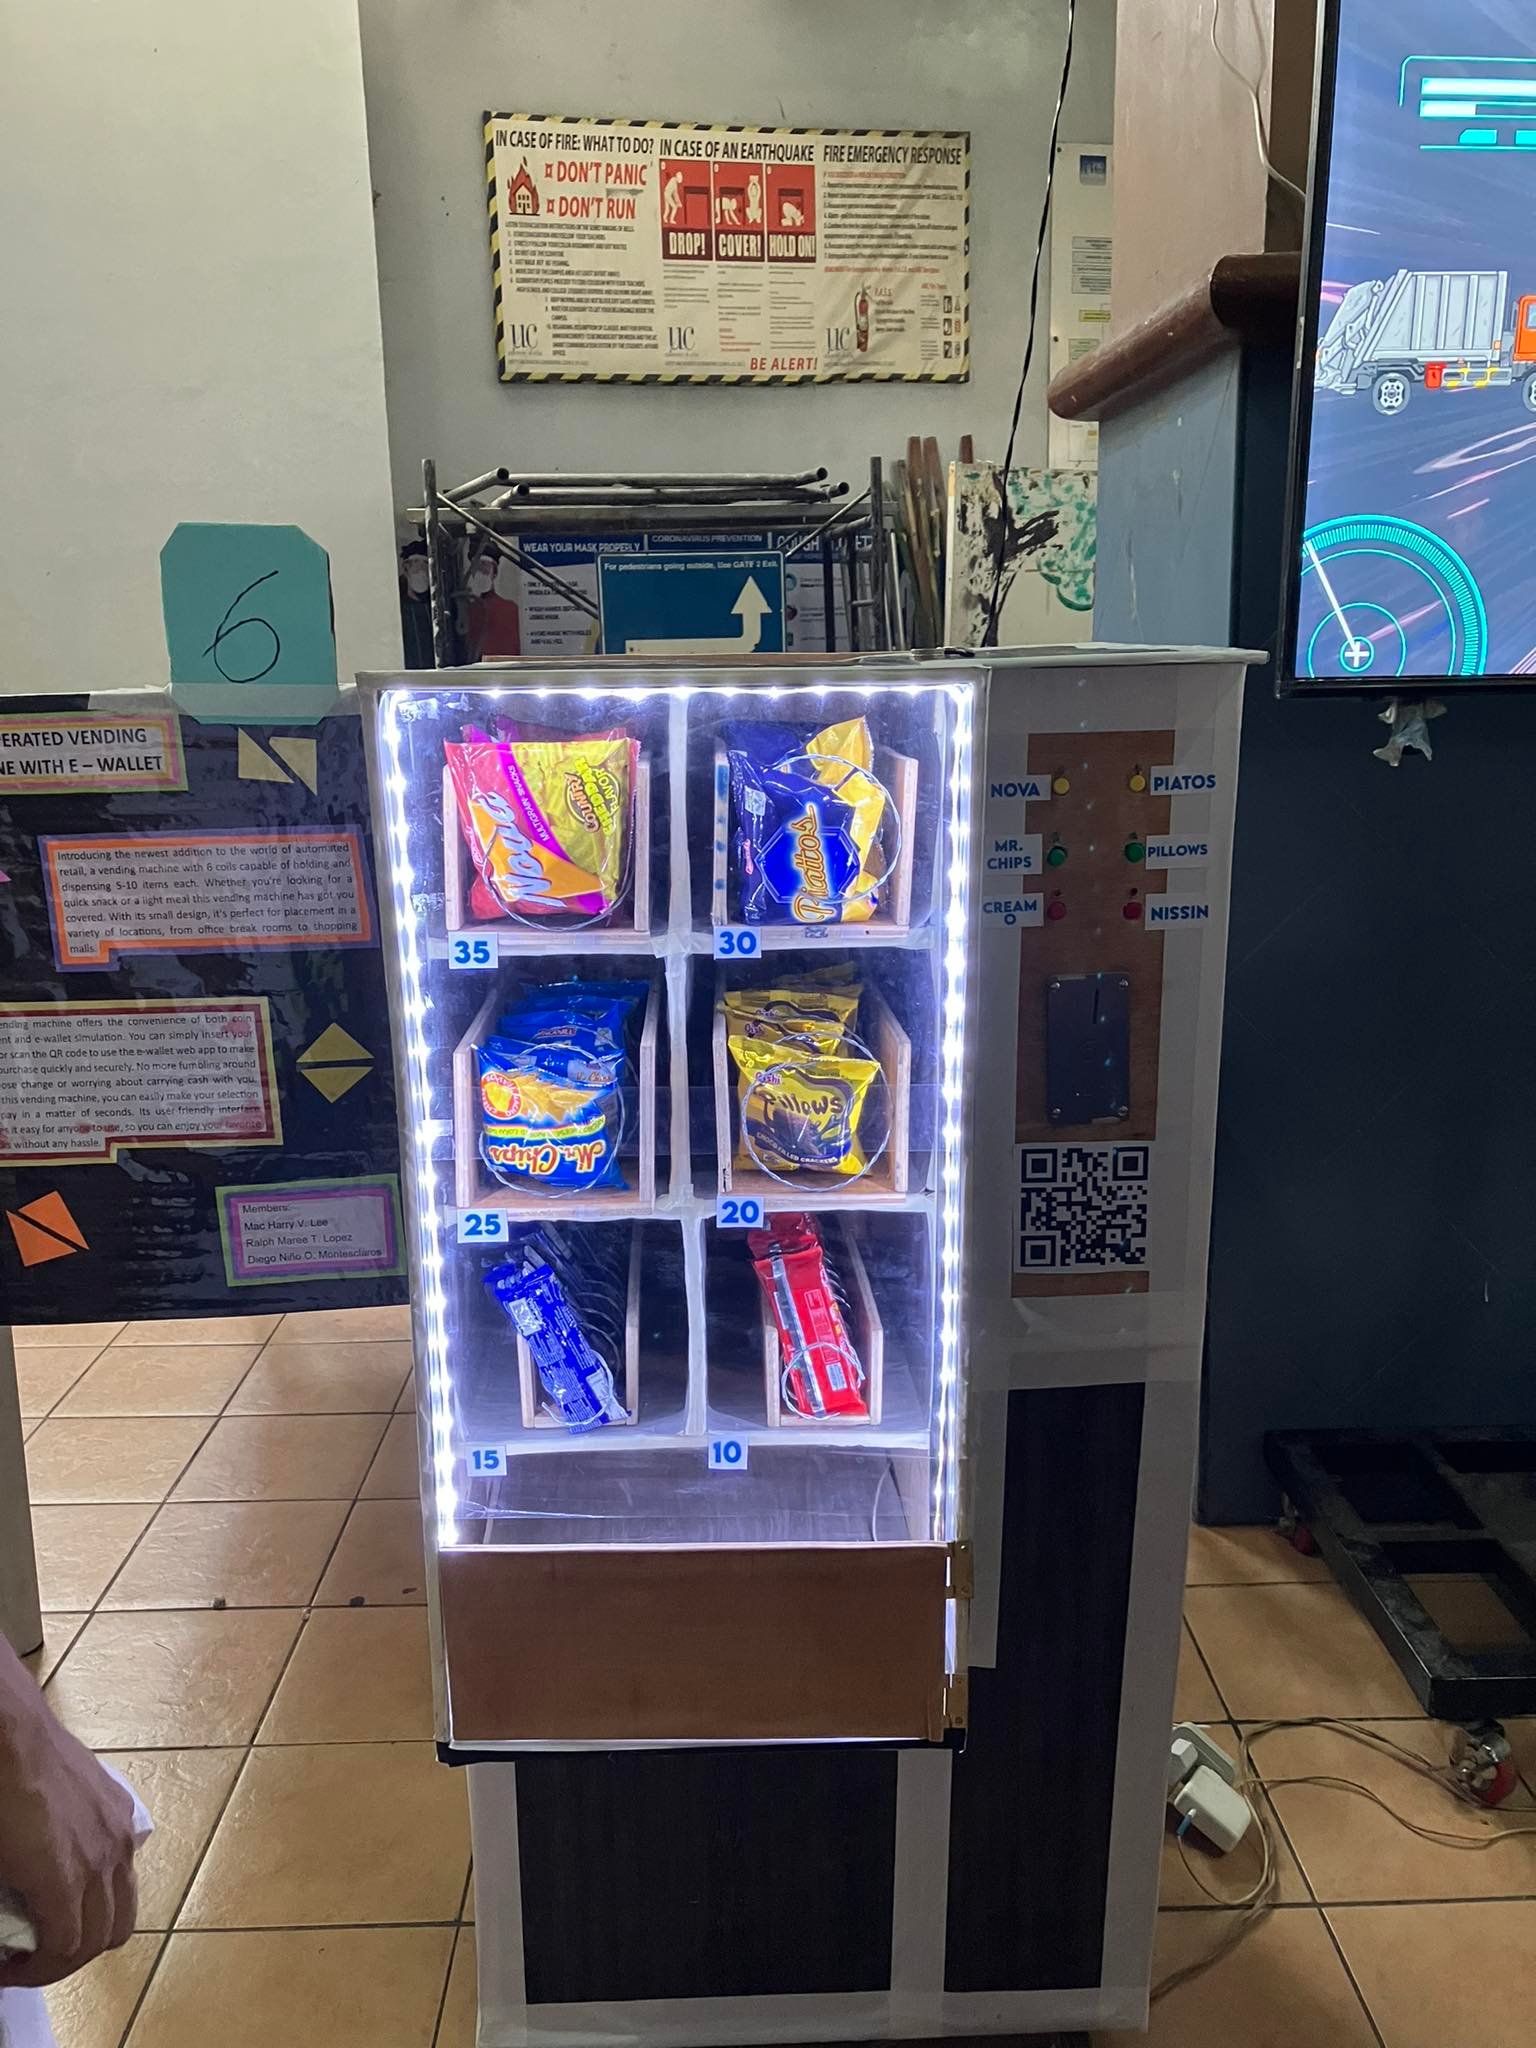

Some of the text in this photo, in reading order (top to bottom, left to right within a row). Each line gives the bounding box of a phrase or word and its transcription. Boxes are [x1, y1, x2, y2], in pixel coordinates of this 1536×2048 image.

[496, 130, 654, 154] IN CASE OF FIRE: WHAT TO DO?
[660, 139, 814, 162] IN CASE OF AN EARTHQUAKE
[824, 145, 961, 164] FIRE EMERGENCY RESPONSE
[557, 161, 647, 185] DON'T PANIC
[559, 196, 636, 219] DON'T RUN
[669, 232, 705, 255] DROP!
[719, 234, 761, 257] COVER!
[769, 235, 815, 257] HOLD ON!
[750, 357, 818, 370] BE ALERT!
[523, 543, 640, 552] WEAR YOUR MASK PROPERLY
[619, 563, 661, 571] pedestrians
[663, 563, 685, 571] going
[202, 571, 280, 683] 6
[0, 728, 147, 747] ERATED VENDING
[20, 759, 64, 774] WITH
[69, 759, 78, 772] E
[97, 756, 162, 772] WALLET
[991, 783, 1040, 797] NOVA
[1154, 775, 1216, 790] PIATOS
[575, 758, 613, 836] CHEDDAR
[593, 768, 620, 816] FLAVOR
[508, 765, 550, 842] MULTIGRAIN SNACKS
[565, 772, 600, 833] COUNTRY
[472, 788, 568, 908] Nova
[995, 840, 1022, 851] MR.
[1148, 844, 1208, 857] PILLOWS
[58, 852, 111, 860] Introducing
[135, 850, 168, 858] newest
[173, 848, 212, 857] addition
[99, 861, 277, 876] vending machine capable
[791, 804, 836, 921] Piattos
[987, 857, 1031, 869] CHIPS
[62, 876, 322, 892] dispensing items Whether looking
[64, 891, 295, 907] quick snack vending machine
[983, 900, 1036, 914] CREAM
[66, 907, 333, 923] covered. With small perfect placement
[1005, 914, 1016, 925] O
[1151, 906, 1208, 920] NISSIN
[68, 923, 292, 938] variety locations, from break rooms
[719, 931, 756, 953] 30
[454, 941, 490, 964] 35
[33, 1015, 227, 1027] machine offers the convenience both
[35, 1031, 198, 1043] e-wallet simply
[32, 1046, 215, 1058] the QR code e-wallet web app
[41, 1064, 72, 1075] quickly
[94, 1063, 134, 1072] securely.
[223, 1060, 256, 1068] around
[21, 1081, 53, 1089] change
[72, 1079, 111, 1089] worrying
[147, 1077, 184, 1086] carrying
[188, 1076, 208, 1084] cash
[213, 1075, 233, 1083] with
[20, 1095, 56, 1104] vending
[58, 1094, 99, 1102] machine,
[194, 1092, 214, 1100] your
[754, 1086, 844, 1116] Pillows
[46, 1108, 134, 1117] matter seconds.
[20, 1122, 200, 1135] easy enjoy
[14, 1139, 49, 1148] without
[756, 1132, 841, 1164] CHOCO FILLED CRACKERS
[489, 1143, 560, 1174] Chips
[721, 1201, 759, 1223] 20
[244, 1223, 265, 1231] Mac
[268, 1221, 294, 1230] Harry
[311, 1219, 328, 1227] Lee
[464, 1213, 501, 1236] 25
[246, 1238, 274, 1247] Ralph
[323, 1234, 352, 1243] Lopez
[248, 1255, 276, 1264] Diego
[319, 1249, 382, 1259] Montesclaros
[713, 1441, 741, 1462] 10
[473, 1450, 499, 1470] 15
